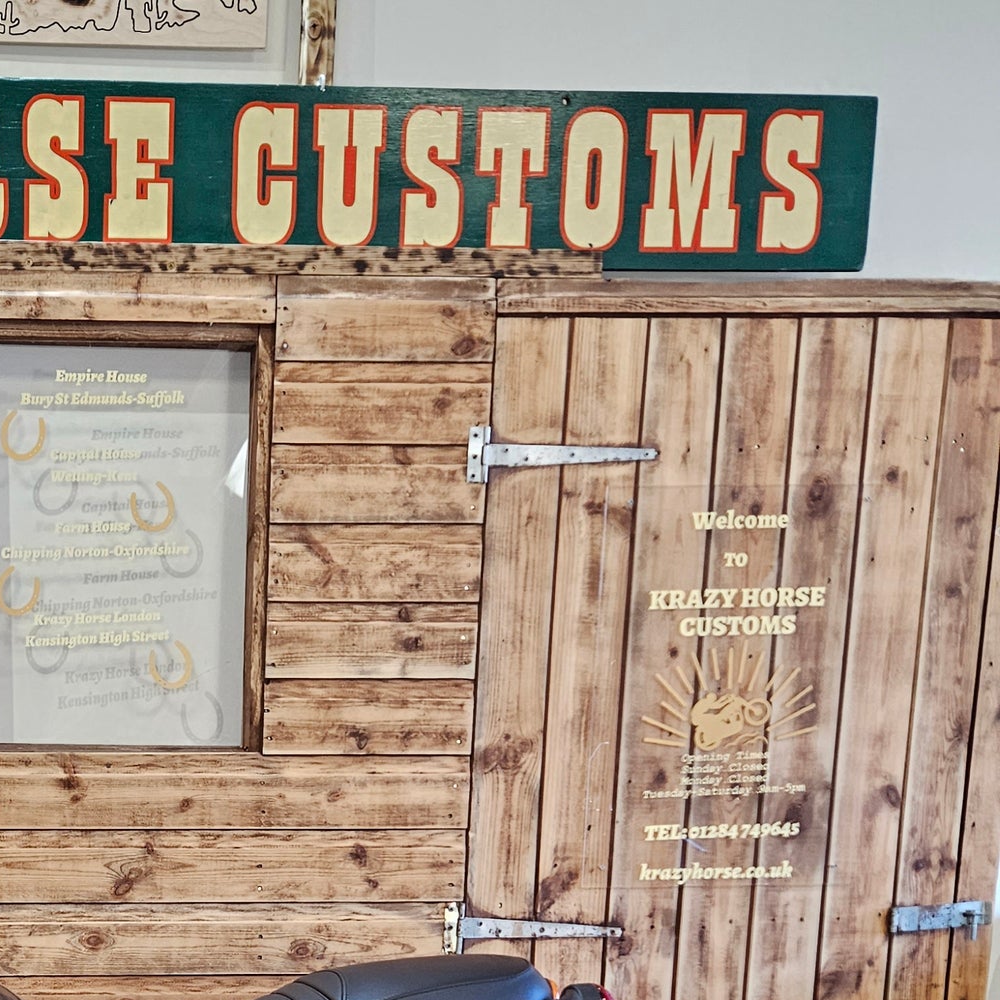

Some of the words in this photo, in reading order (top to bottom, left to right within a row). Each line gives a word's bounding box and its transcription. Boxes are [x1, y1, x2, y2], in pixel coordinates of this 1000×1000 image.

[231, 101, 823, 252] CUSTOMS
[55, 368, 105, 386] Empire
[106, 369, 147, 384] House
[20, 392, 54, 408] Bury
[54, 391, 69, 405] St
[69, 390, 185, 408] Edmunds-Suffolk
[143, 427, 183, 440] House
[55, 521, 90, 534] Farm
[92, 520, 131, 534] House
[692, 509, 790, 530] Welcome
[1, 546, 62, 561] Chipping
[63, 543, 189, 560] Norton-Oxfordshire
[724, 552, 748, 567] TO
[83, 571, 120, 585] Farm
[121, 569, 160, 581] House
[648, 588, 738, 610] KRAZY
[740, 586, 826, 608] HORSE
[34, 613, 73, 627] Krazy
[74, 612, 113, 625] Horse
[113, 610, 161, 623] London
[680, 615, 797, 637] CUSTOMS
[25, 632, 97, 649] Kensington
[99, 631, 130, 646] High
[132, 630, 169, 641] Street
[640, 860, 794, 885] krazyhorse.co.uk
